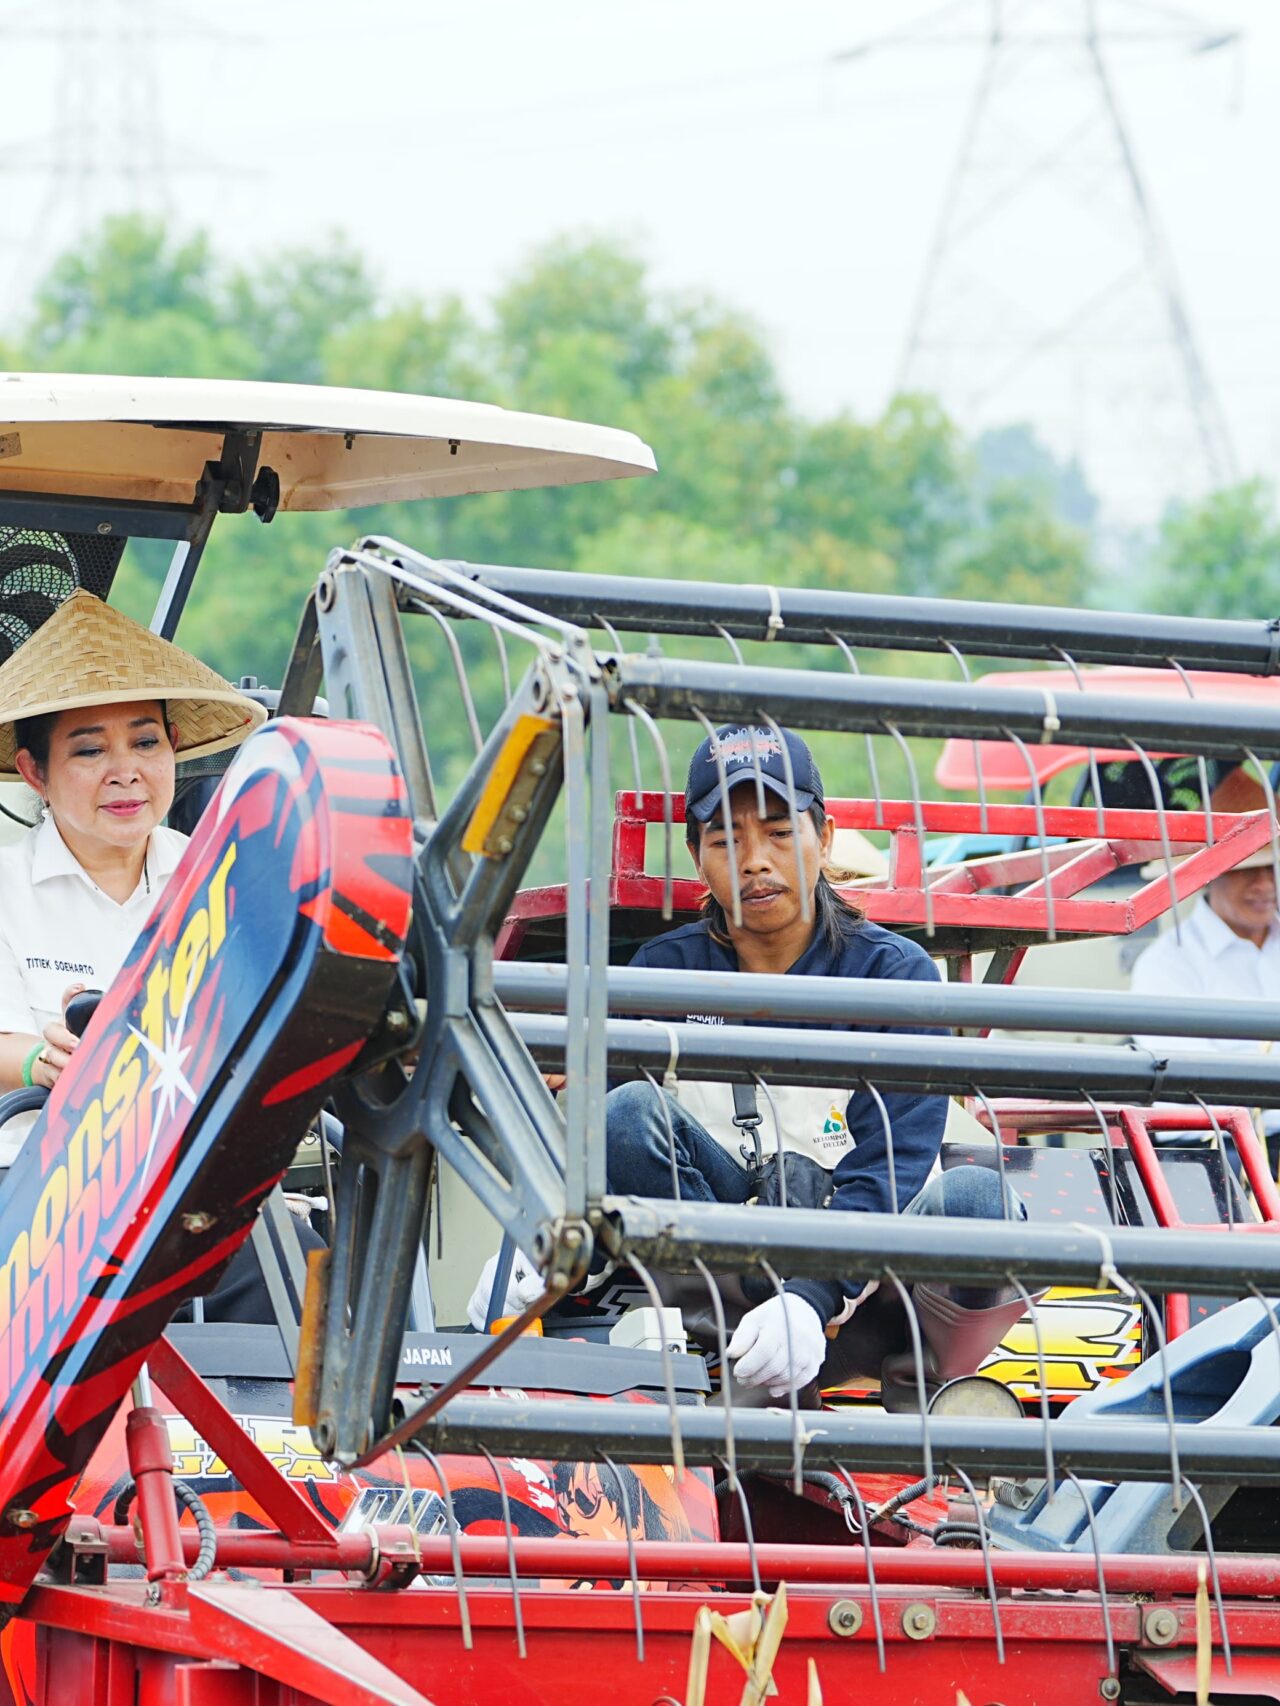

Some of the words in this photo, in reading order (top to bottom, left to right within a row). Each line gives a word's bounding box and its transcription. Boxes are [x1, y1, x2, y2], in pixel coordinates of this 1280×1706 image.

[26, 957, 52, 969] TITIEK
[54, 960, 94, 976] SOEHARTO
[403, 1347, 452, 1366] JAPAN
